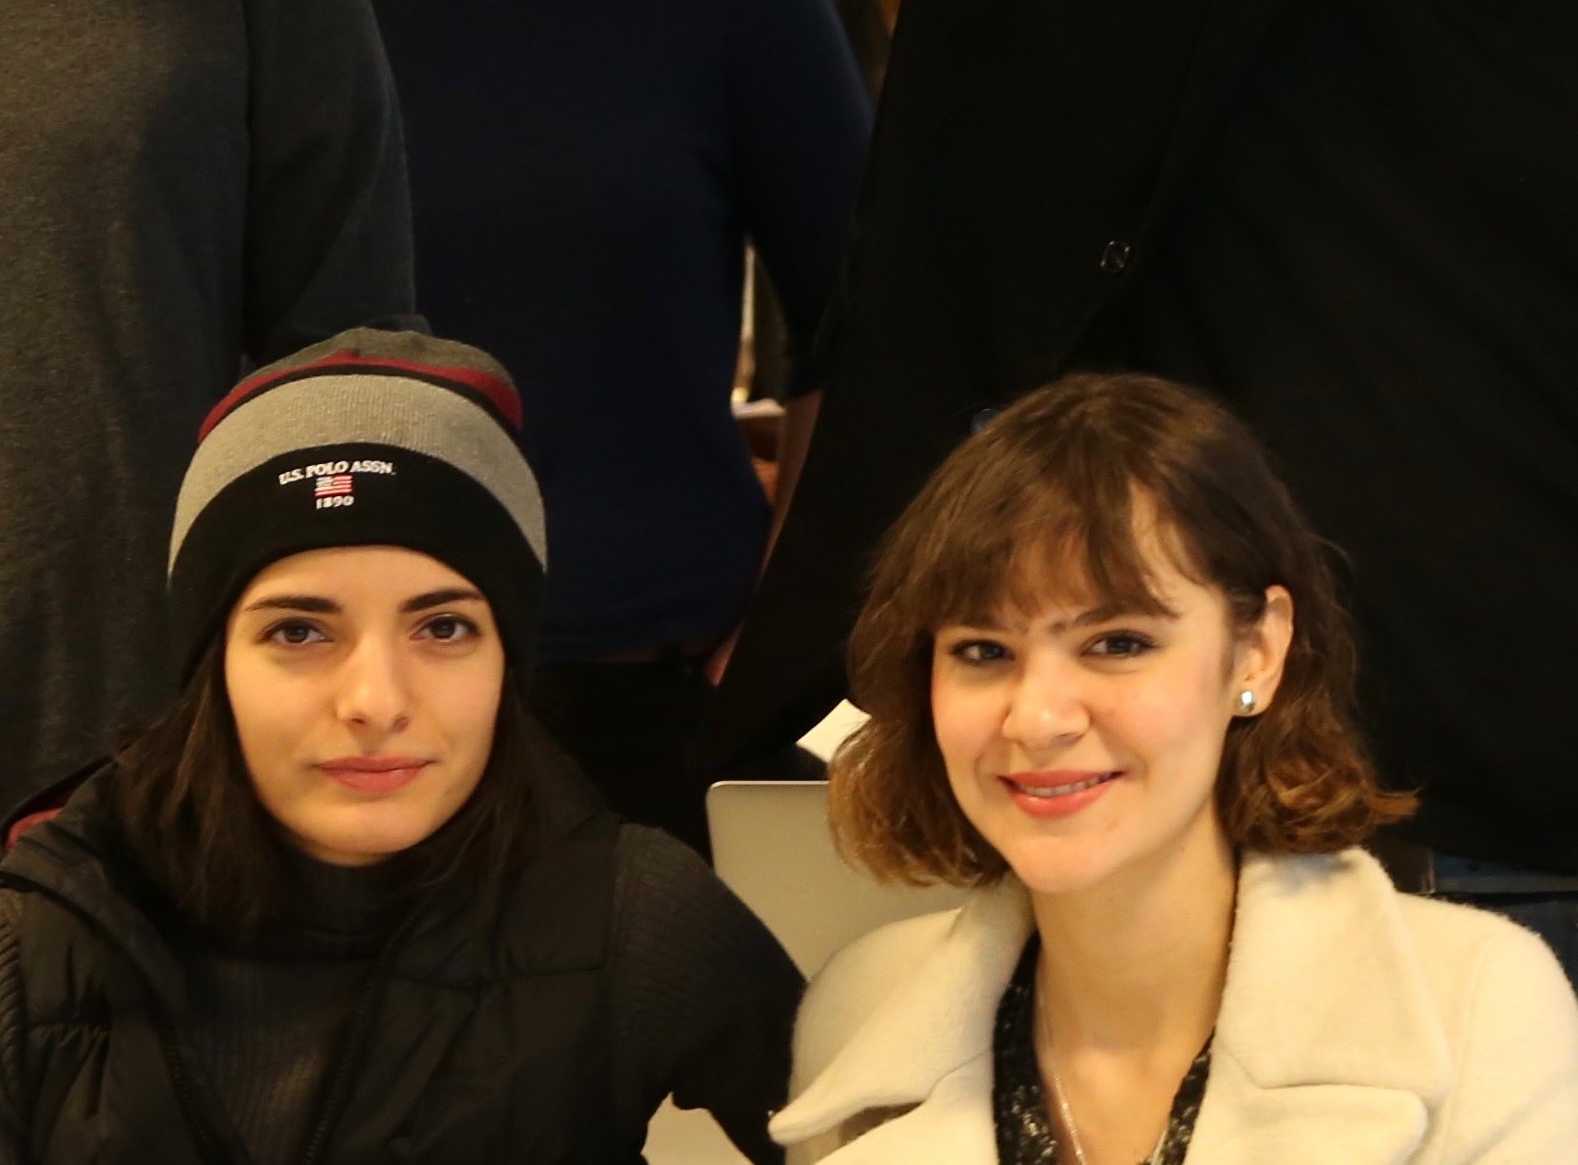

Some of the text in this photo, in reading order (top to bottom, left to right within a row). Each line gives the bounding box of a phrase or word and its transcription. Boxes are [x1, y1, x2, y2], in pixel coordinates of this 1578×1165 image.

[278, 468, 305, 485] U.S.
[305, 460, 349, 478] POLO
[316, 496, 354, 509] 1890
